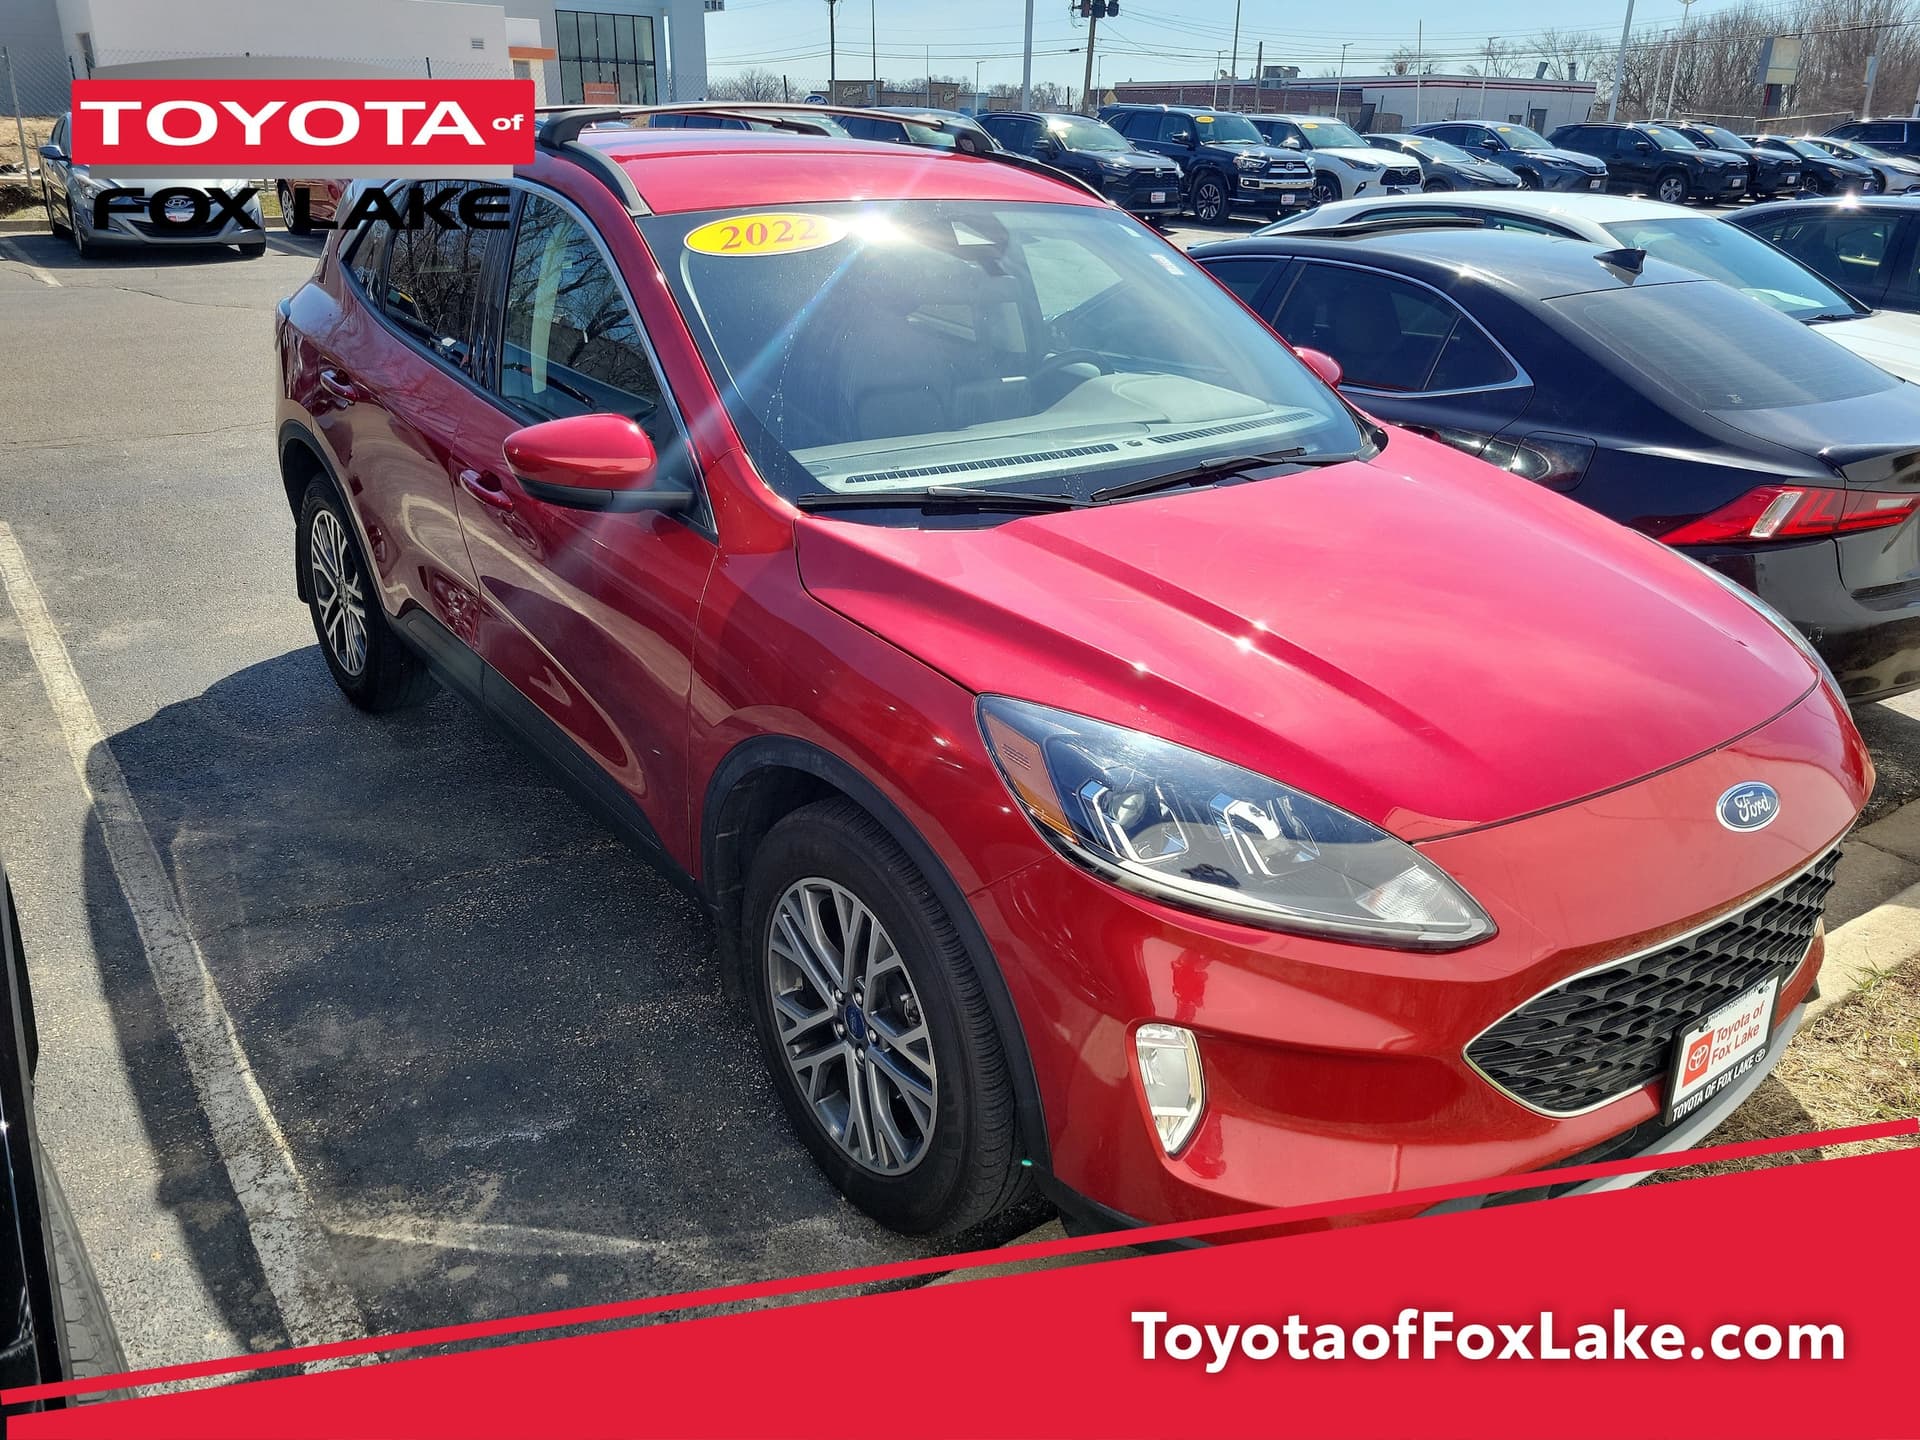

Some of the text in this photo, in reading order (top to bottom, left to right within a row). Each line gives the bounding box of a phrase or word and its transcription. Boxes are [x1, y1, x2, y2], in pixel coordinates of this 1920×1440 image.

[720, 208, 818, 251] 2022
[1734, 790, 1771, 822] Ford
[1716, 1001, 1765, 1043] Toyota of
[1711, 1023, 1760, 1065] Fox Lake
[1672, 1055, 1755, 1122] TOYOTA OF FOX LAKE
